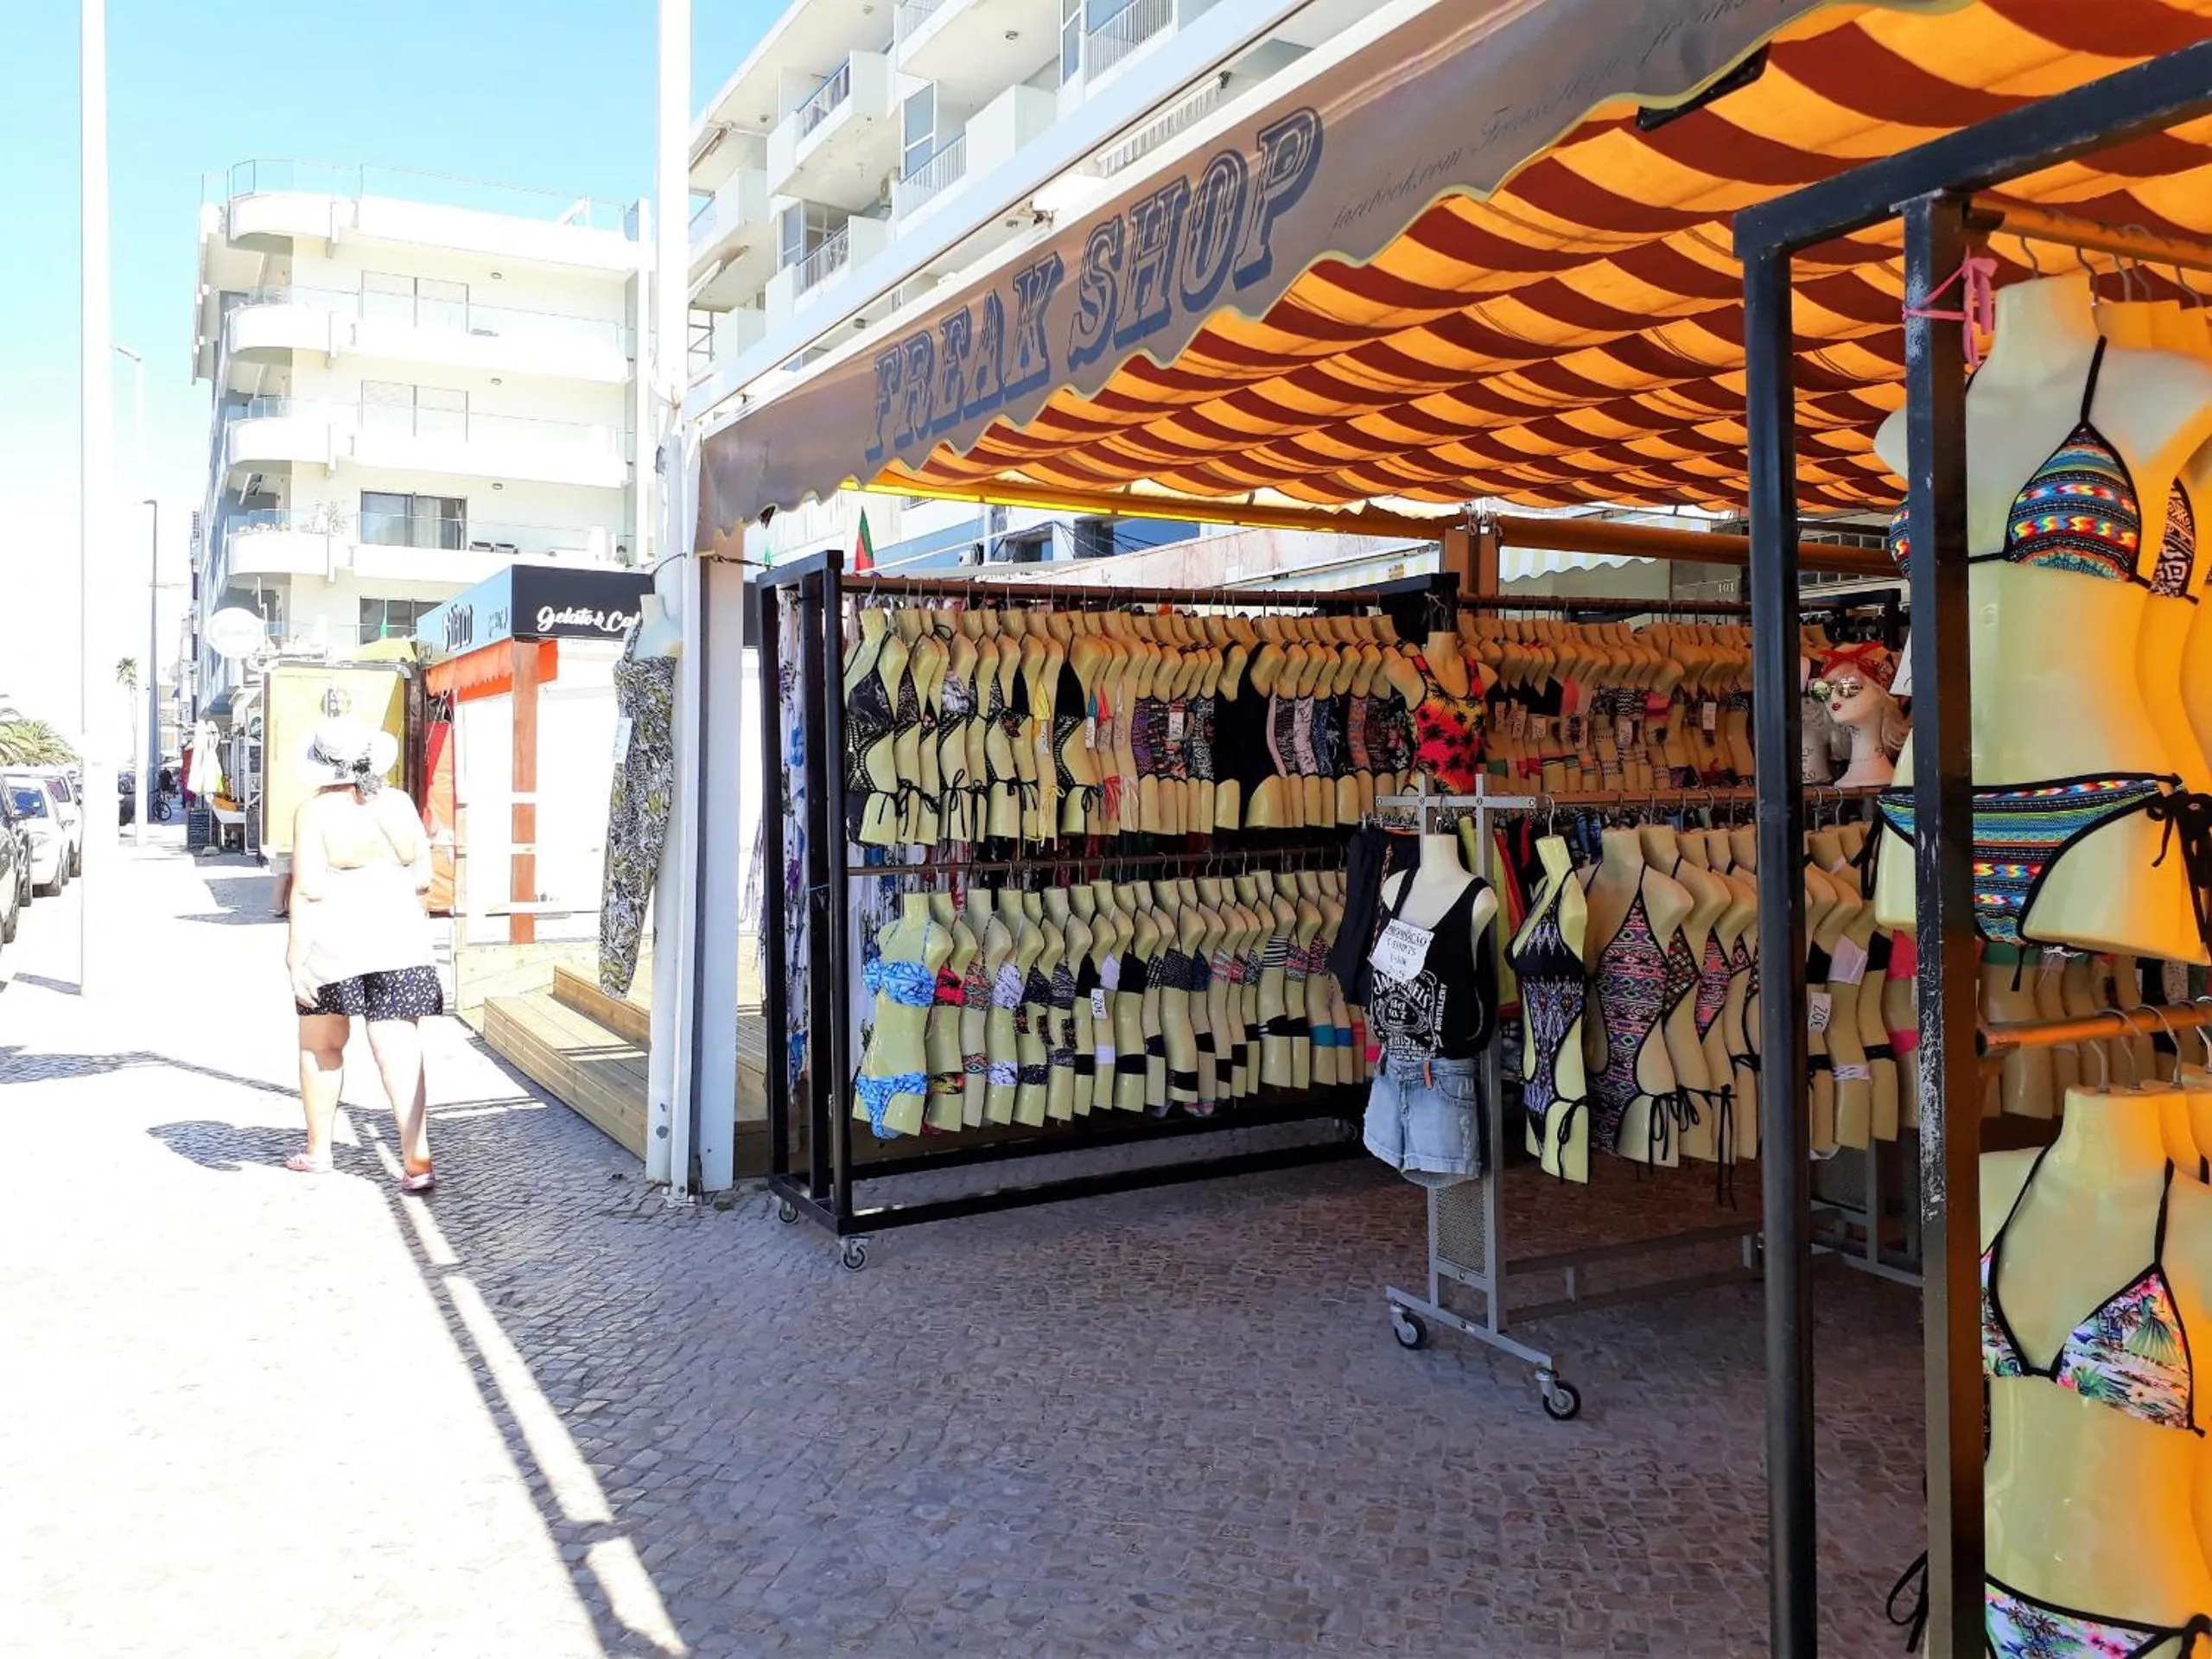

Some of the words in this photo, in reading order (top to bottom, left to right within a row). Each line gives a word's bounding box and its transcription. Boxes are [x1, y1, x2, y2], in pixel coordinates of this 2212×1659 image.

[865, 251, 1064, 462] FREAK
[1068, 106, 1324, 372] SHOP
[537, 606, 594, 632] Gelato
